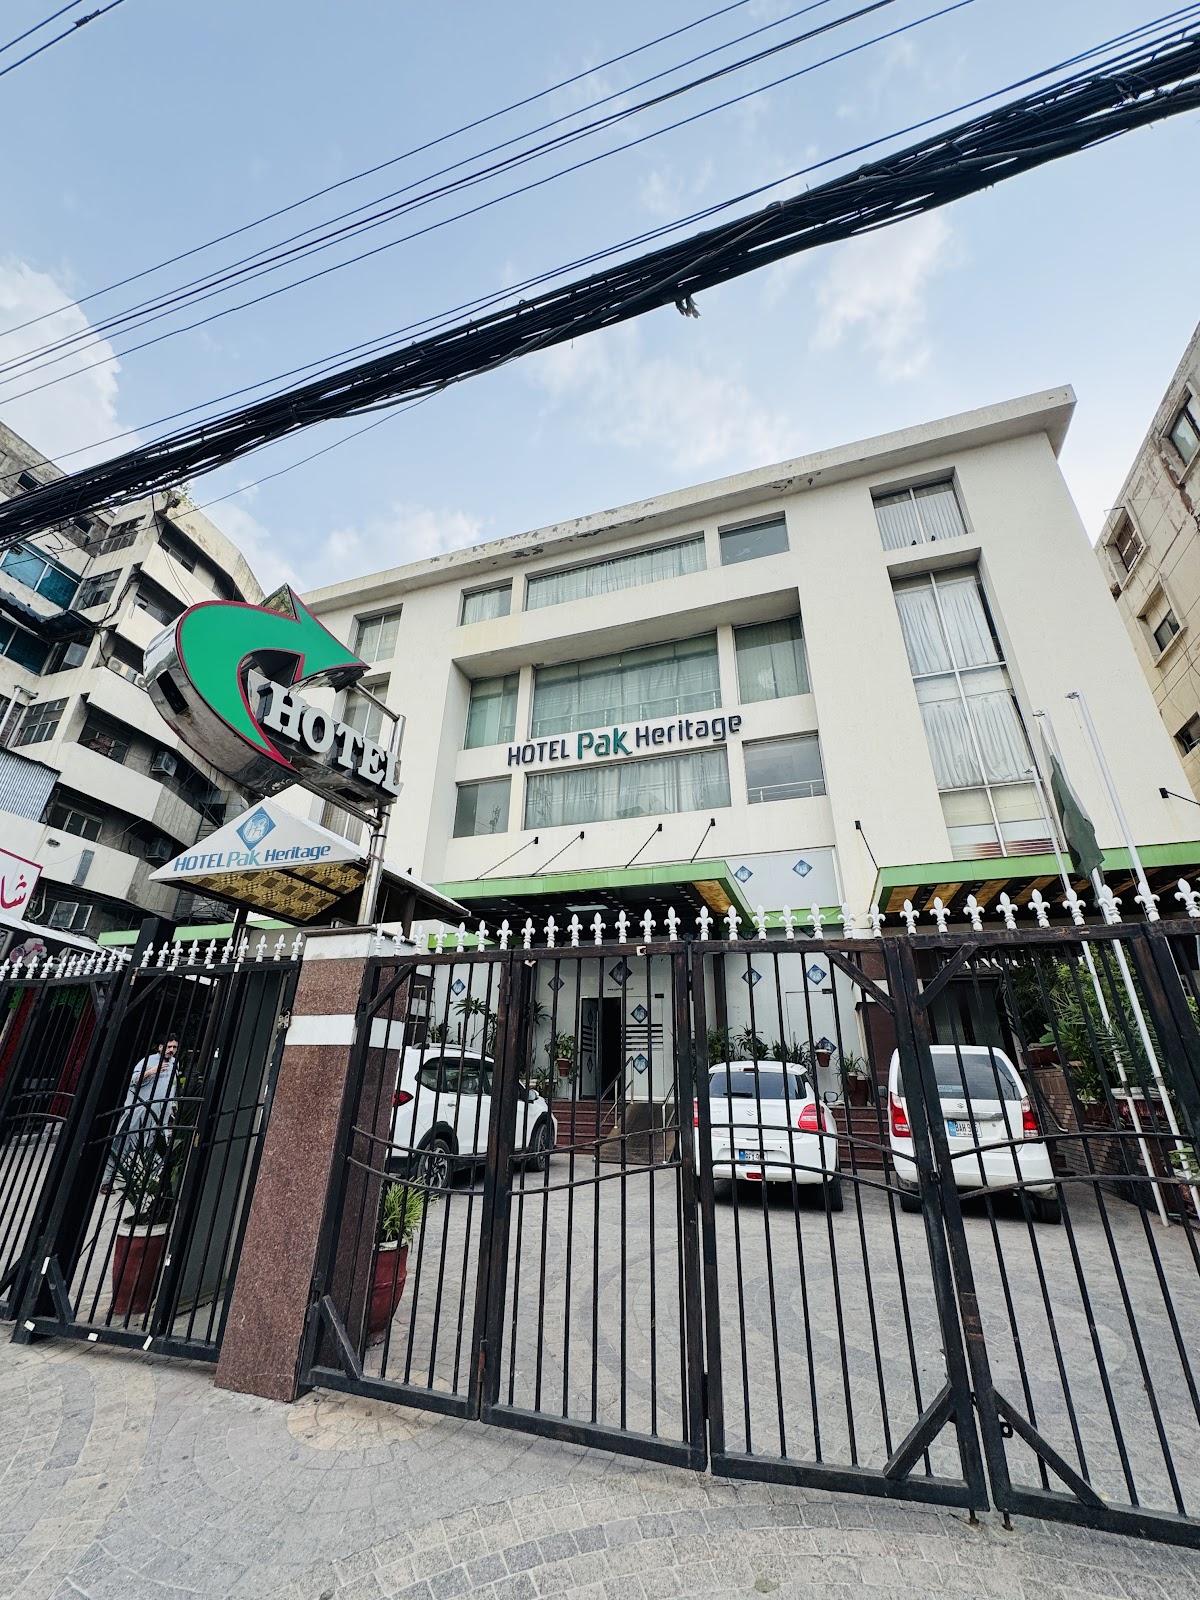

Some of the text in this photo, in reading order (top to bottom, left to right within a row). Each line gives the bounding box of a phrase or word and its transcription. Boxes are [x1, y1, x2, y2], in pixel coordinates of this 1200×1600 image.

[261, 681, 404, 797] HOTEL
[507, 715, 742, 767] HOTEL Pak Heritage
[173, 845, 331, 872] HOTEL Pak Heritage
